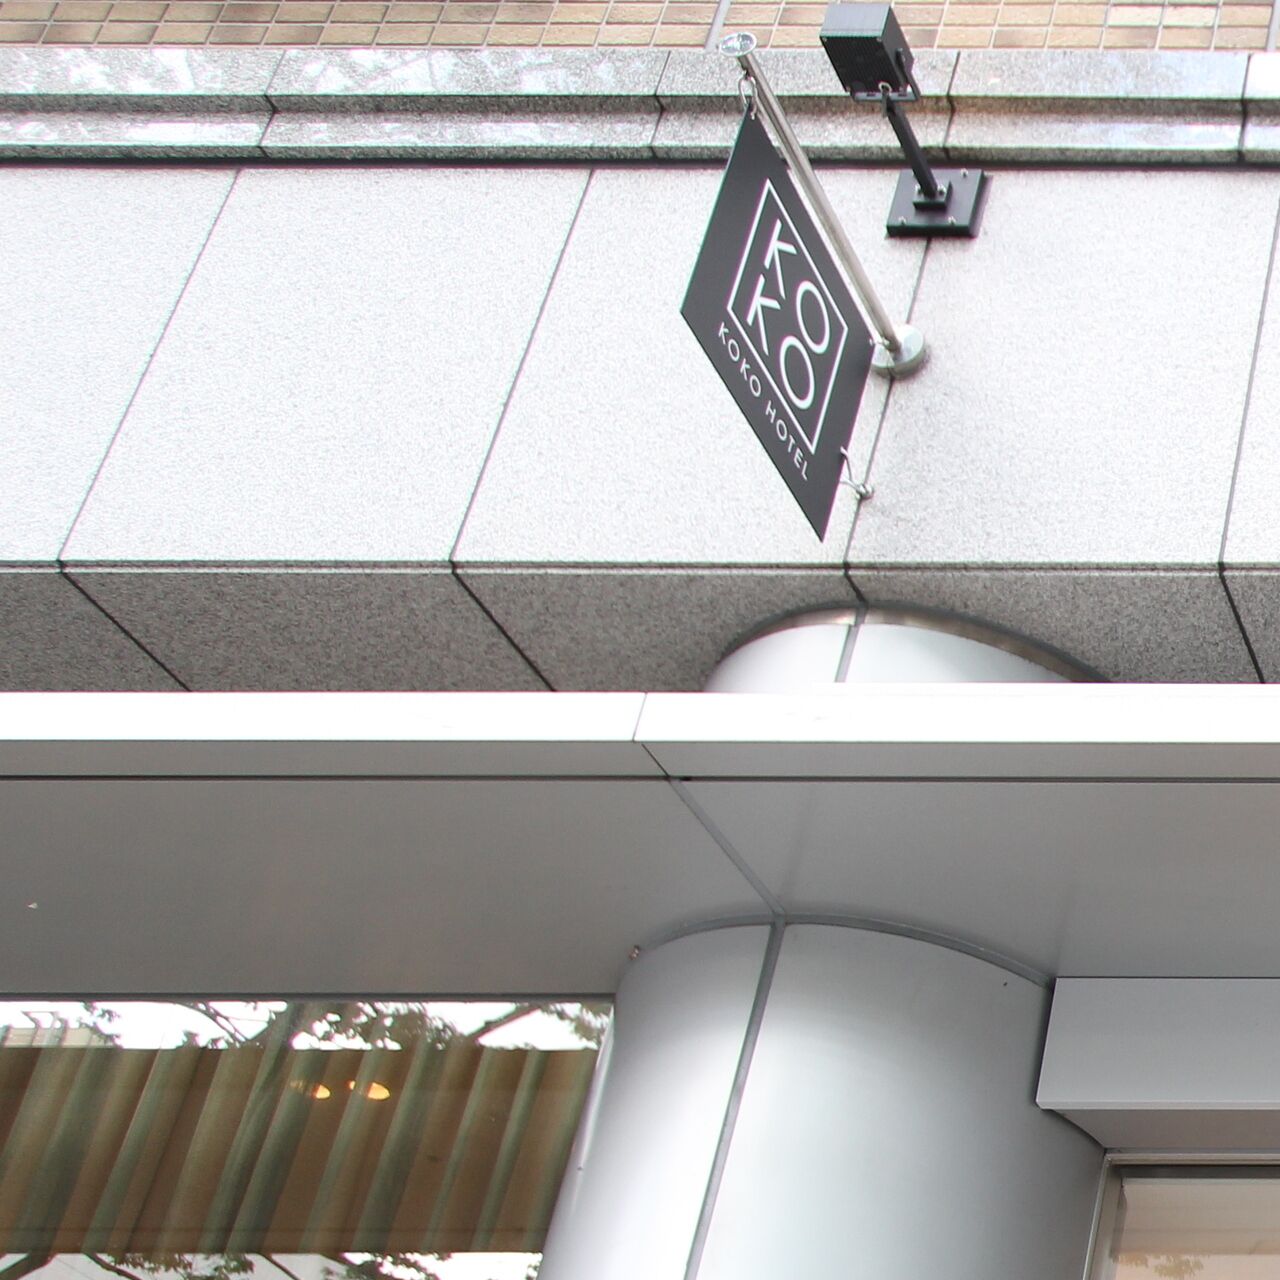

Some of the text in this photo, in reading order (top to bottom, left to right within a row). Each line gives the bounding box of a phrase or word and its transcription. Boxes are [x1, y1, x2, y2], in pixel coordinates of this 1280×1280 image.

[746, 273, 815, 411] KO
[764, 217, 831, 355] KO
[718, 322, 808, 480] KOKO HOTEL
